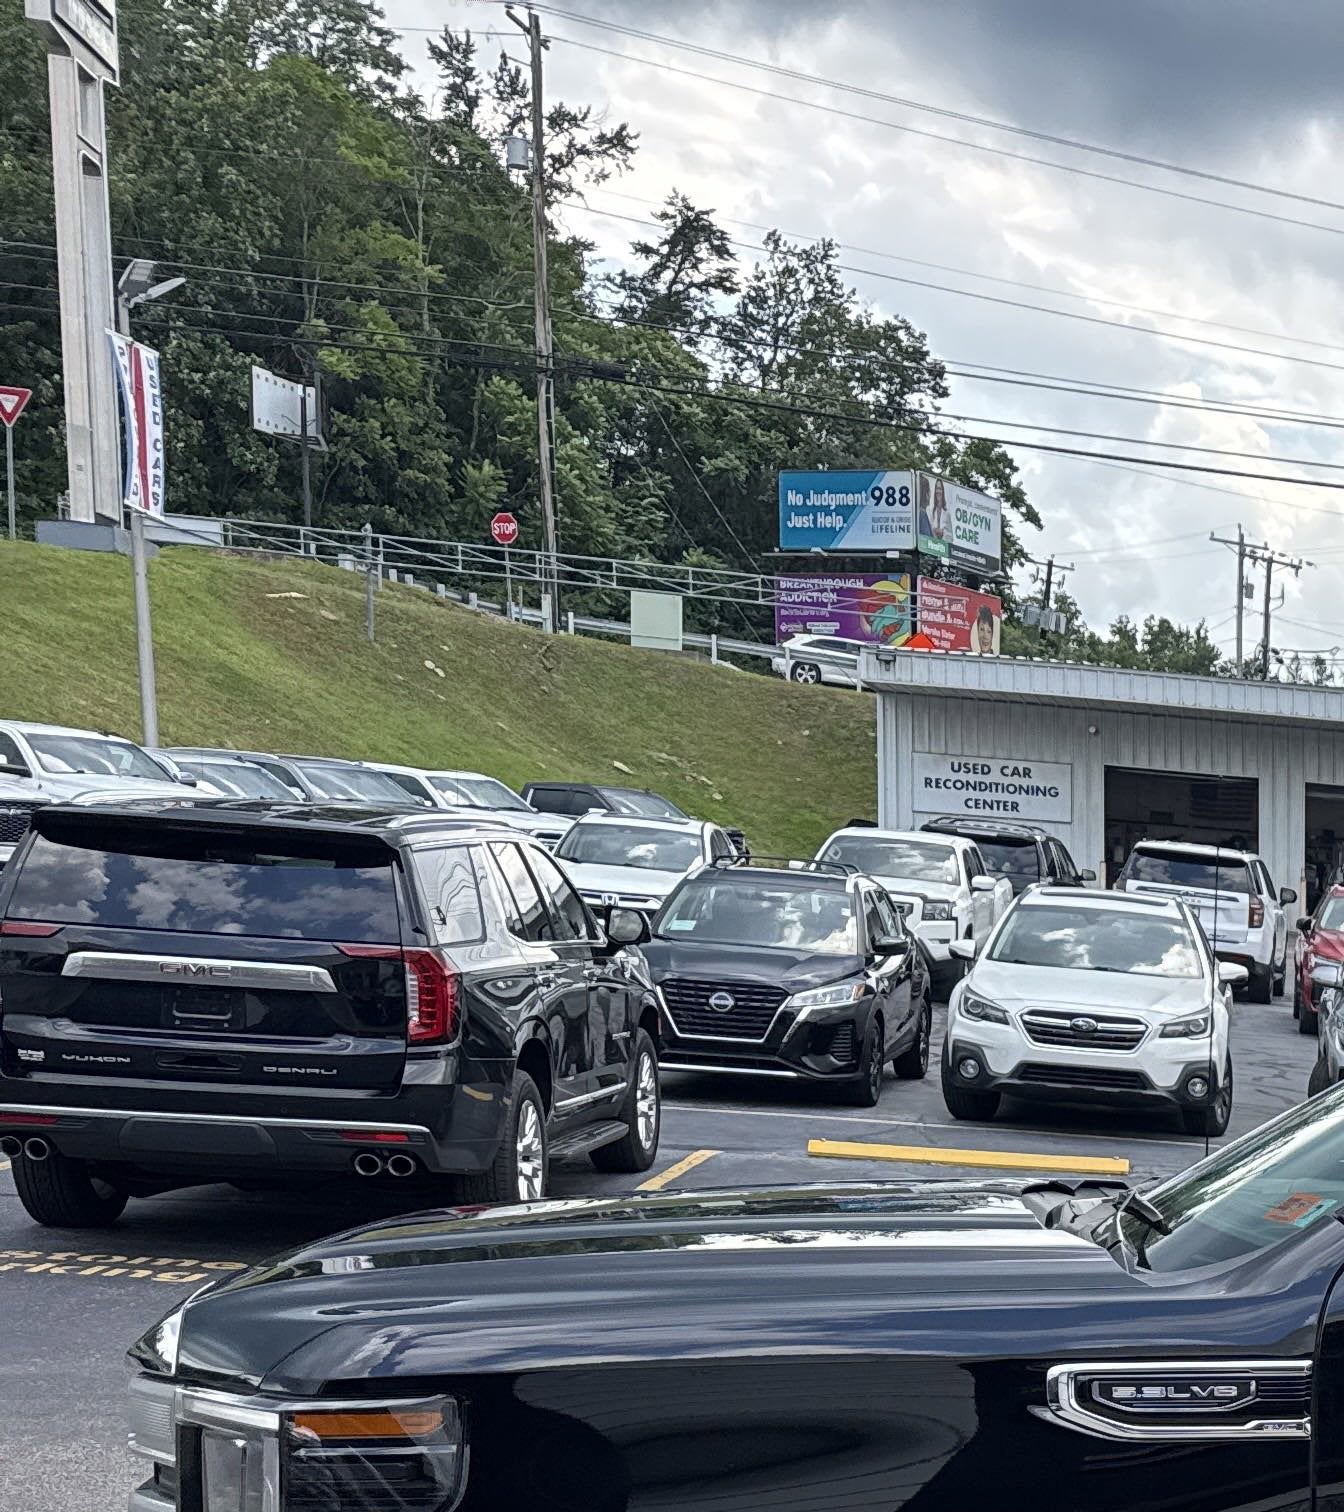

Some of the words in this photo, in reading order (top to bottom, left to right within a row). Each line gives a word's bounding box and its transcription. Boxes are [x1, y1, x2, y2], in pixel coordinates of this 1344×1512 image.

[146, 355, 160, 426] USED
[152, 438, 162, 507] CARS
[787, 490, 803, 506] No
[871, 485, 911, 507] 988
[493, 522, 516, 535] STOP
[787, 512, 814, 528] Just
[816, 512, 847, 536] Help.
[955, 507, 992, 532] OB/GYN
[871, 524, 911, 534] LIFELINE
[955, 526, 979, 546] CARE
[950, 761, 992, 775] USED
[1000, 765, 1032, 779] CAR
[924, 777, 1060, 798] RECONDITIONING
[964, 797, 1020, 813] CENTER
[159, 962, 232, 977] GMC
[62, 1053, 131, 1063] YUKON
[263, 1066, 337, 1074] DENALI
